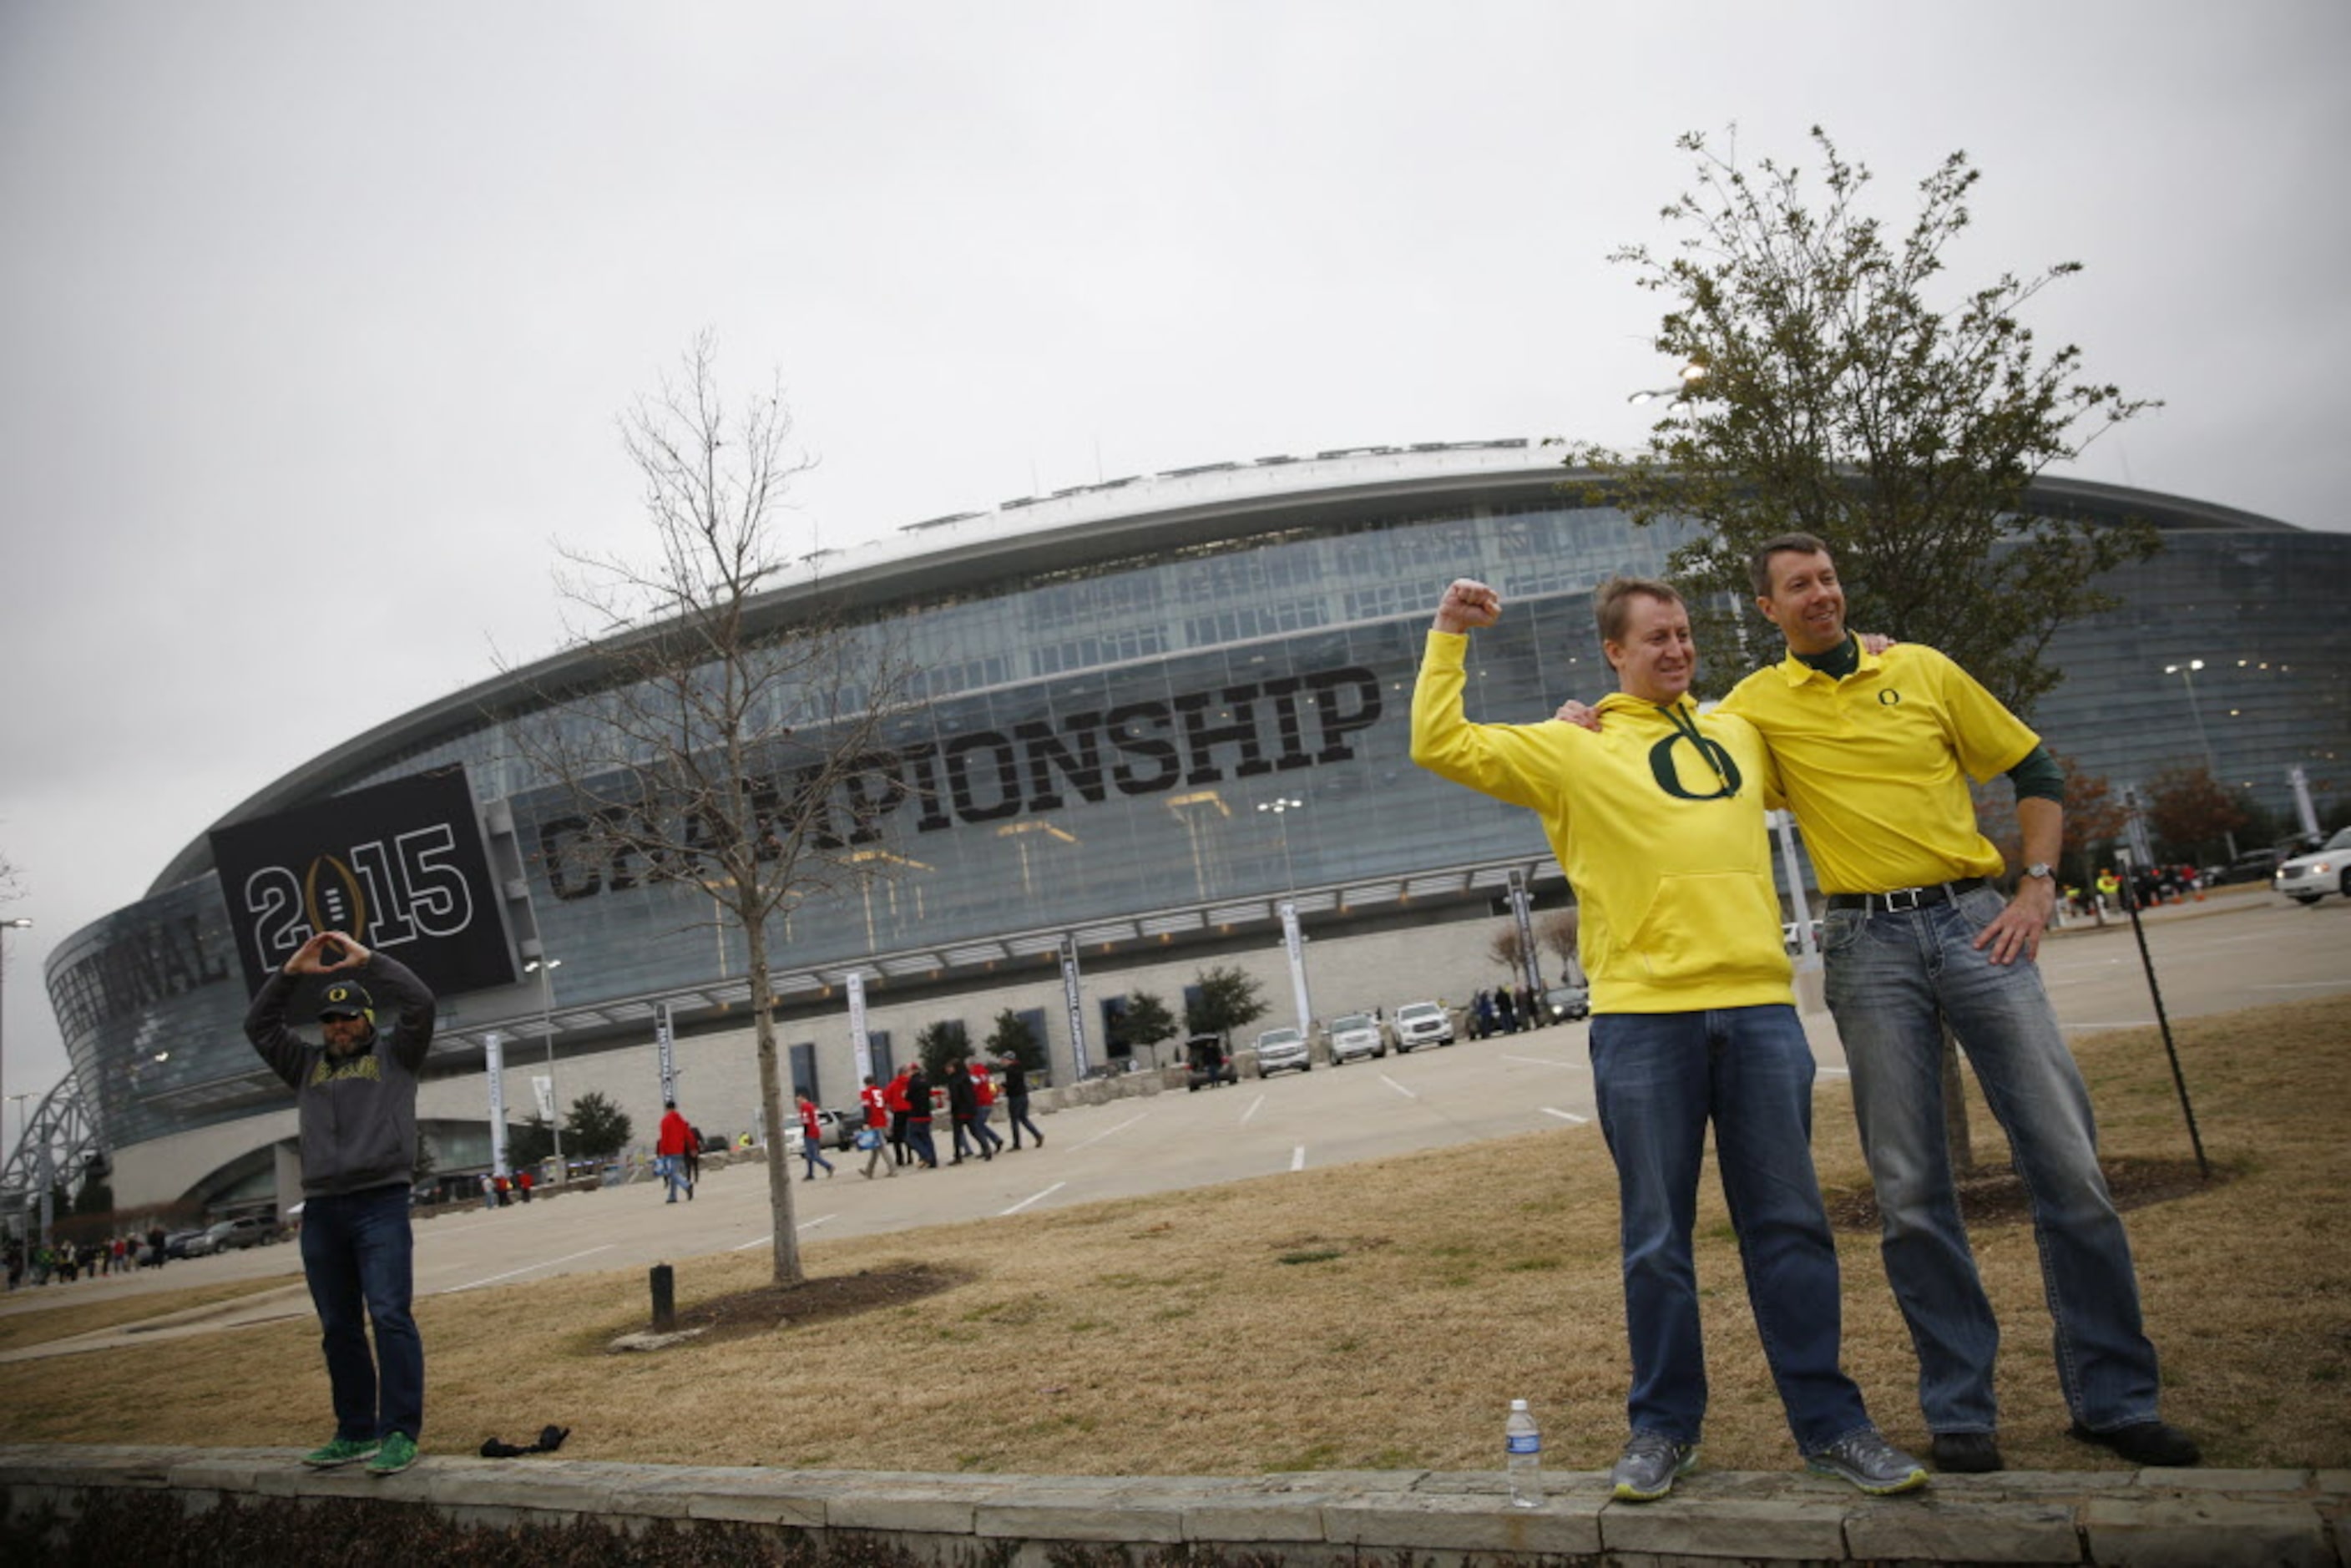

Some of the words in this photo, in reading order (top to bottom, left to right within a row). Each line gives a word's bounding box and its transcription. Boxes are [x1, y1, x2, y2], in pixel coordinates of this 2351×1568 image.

[1878, 688, 1899, 706] O
[542, 665, 1383, 901] CHAMPIONSHIP
[1648, 731, 1742, 801] O
[329, 988, 348, 1002] O
